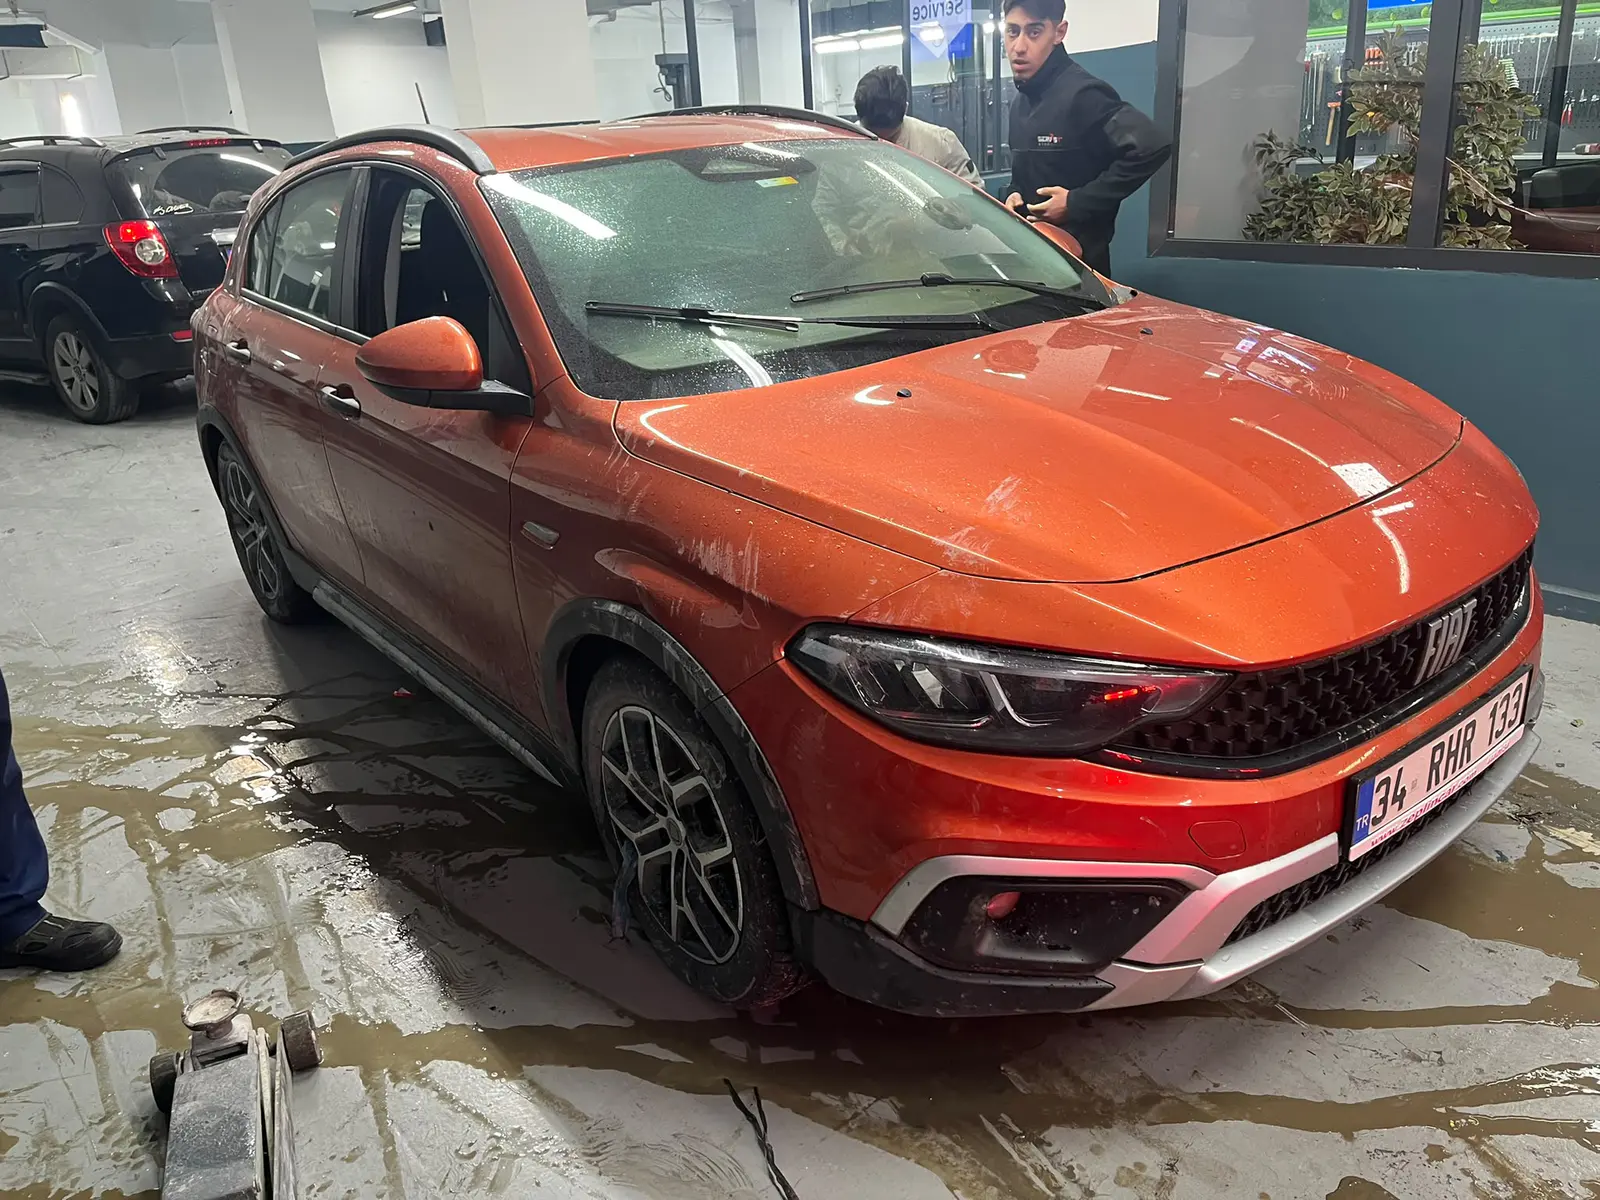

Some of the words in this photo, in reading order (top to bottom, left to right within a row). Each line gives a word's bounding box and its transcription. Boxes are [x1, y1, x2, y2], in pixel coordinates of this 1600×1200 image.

[1414, 598, 1477, 686] FIAT
[1371, 766, 1407, 826] 34
[1426, 719, 1477, 792] RHR
[1488, 682, 1523, 746] 133
[1356, 813, 1369, 831] TR
